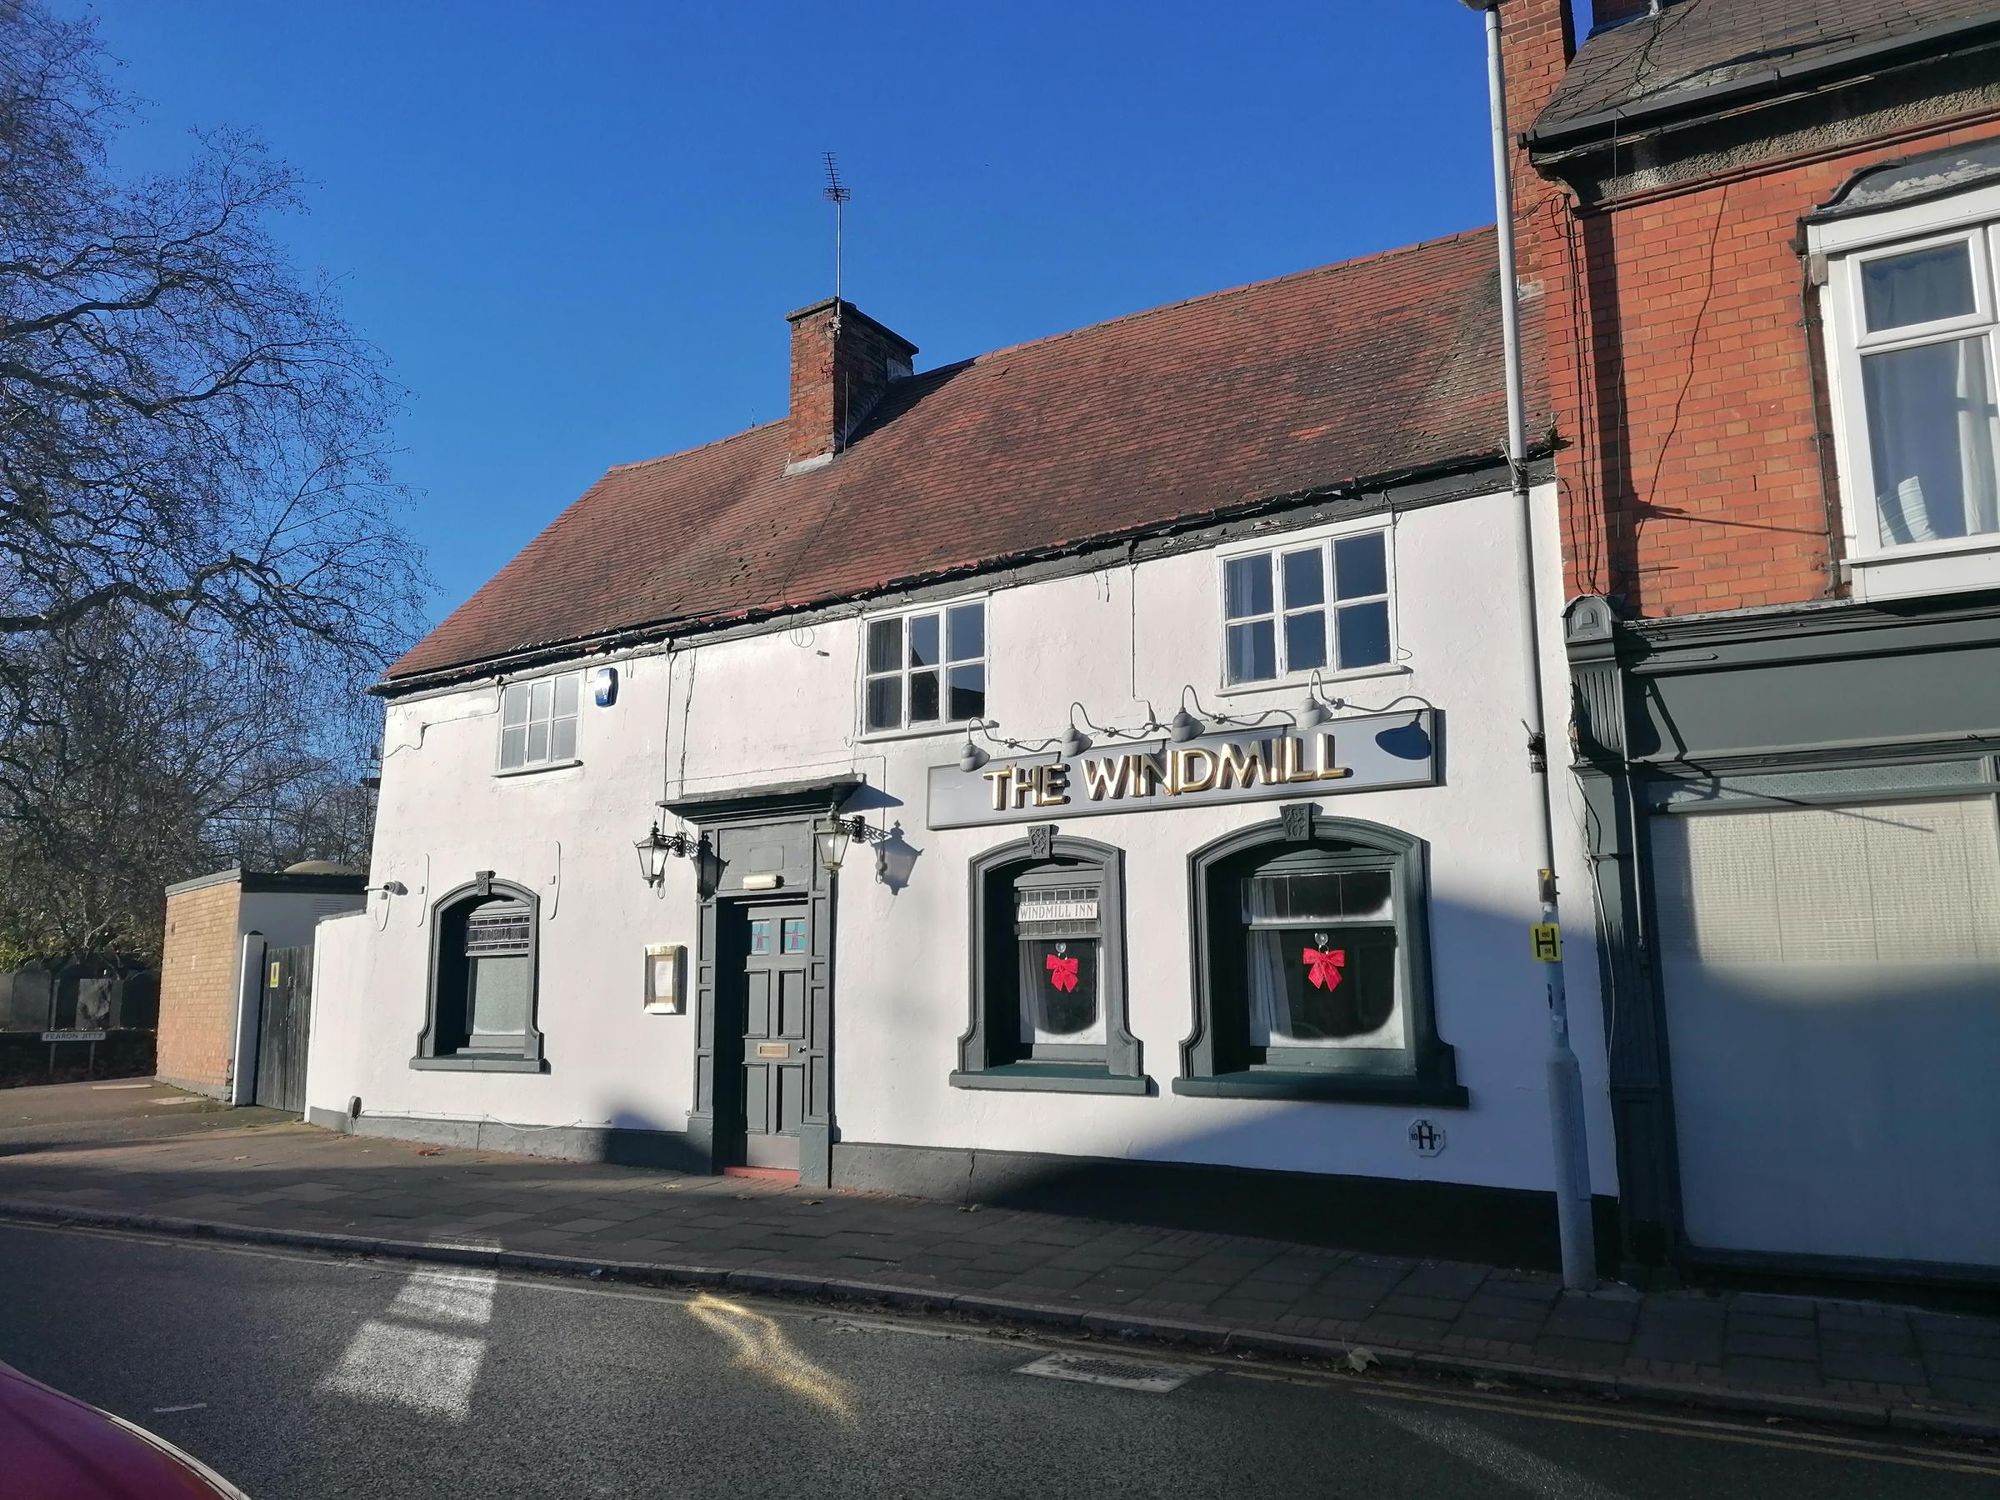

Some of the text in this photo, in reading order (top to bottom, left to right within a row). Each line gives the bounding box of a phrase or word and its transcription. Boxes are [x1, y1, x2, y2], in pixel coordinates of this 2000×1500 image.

[983, 732, 1354, 811] THE WINDMILL
[1541, 870, 1551, 880] 7
[1020, 903, 1094, 919] WINDMILL INN
[1535, 927, 1557, 958] H
[1416, 1125, 1435, 1150] H
